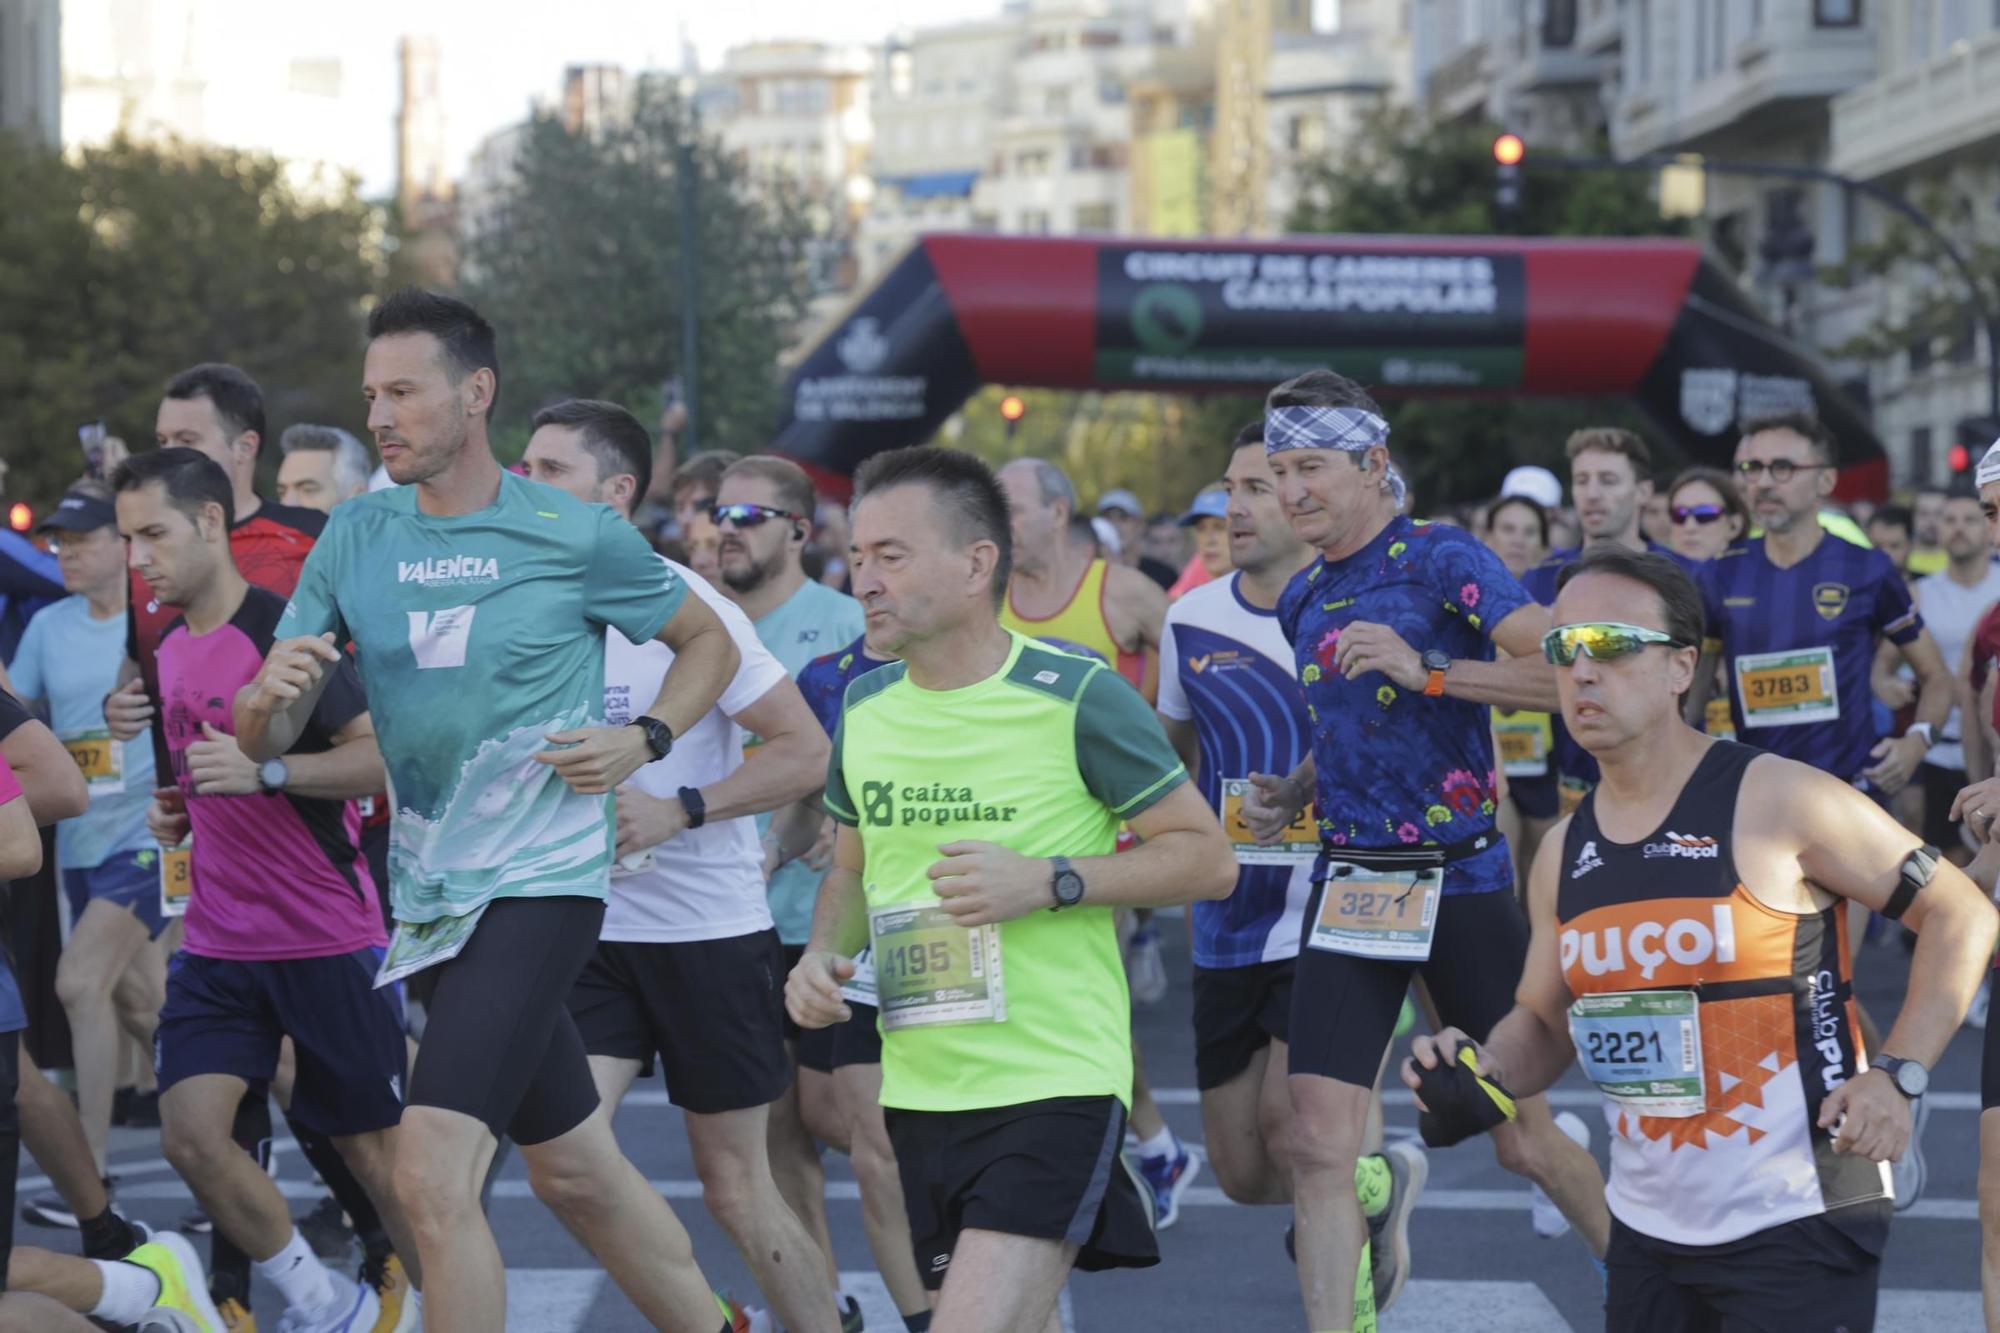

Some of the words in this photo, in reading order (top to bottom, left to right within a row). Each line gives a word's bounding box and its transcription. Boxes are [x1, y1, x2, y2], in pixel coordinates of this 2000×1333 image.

[1751, 675, 1809, 698] 3783
[902, 783, 973, 802] caixa
[901, 803, 1017, 825] popular
[1340, 892, 1407, 918] 3271
[885, 942, 950, 977] 4195
[1588, 1030, 1662, 1063] 2221
